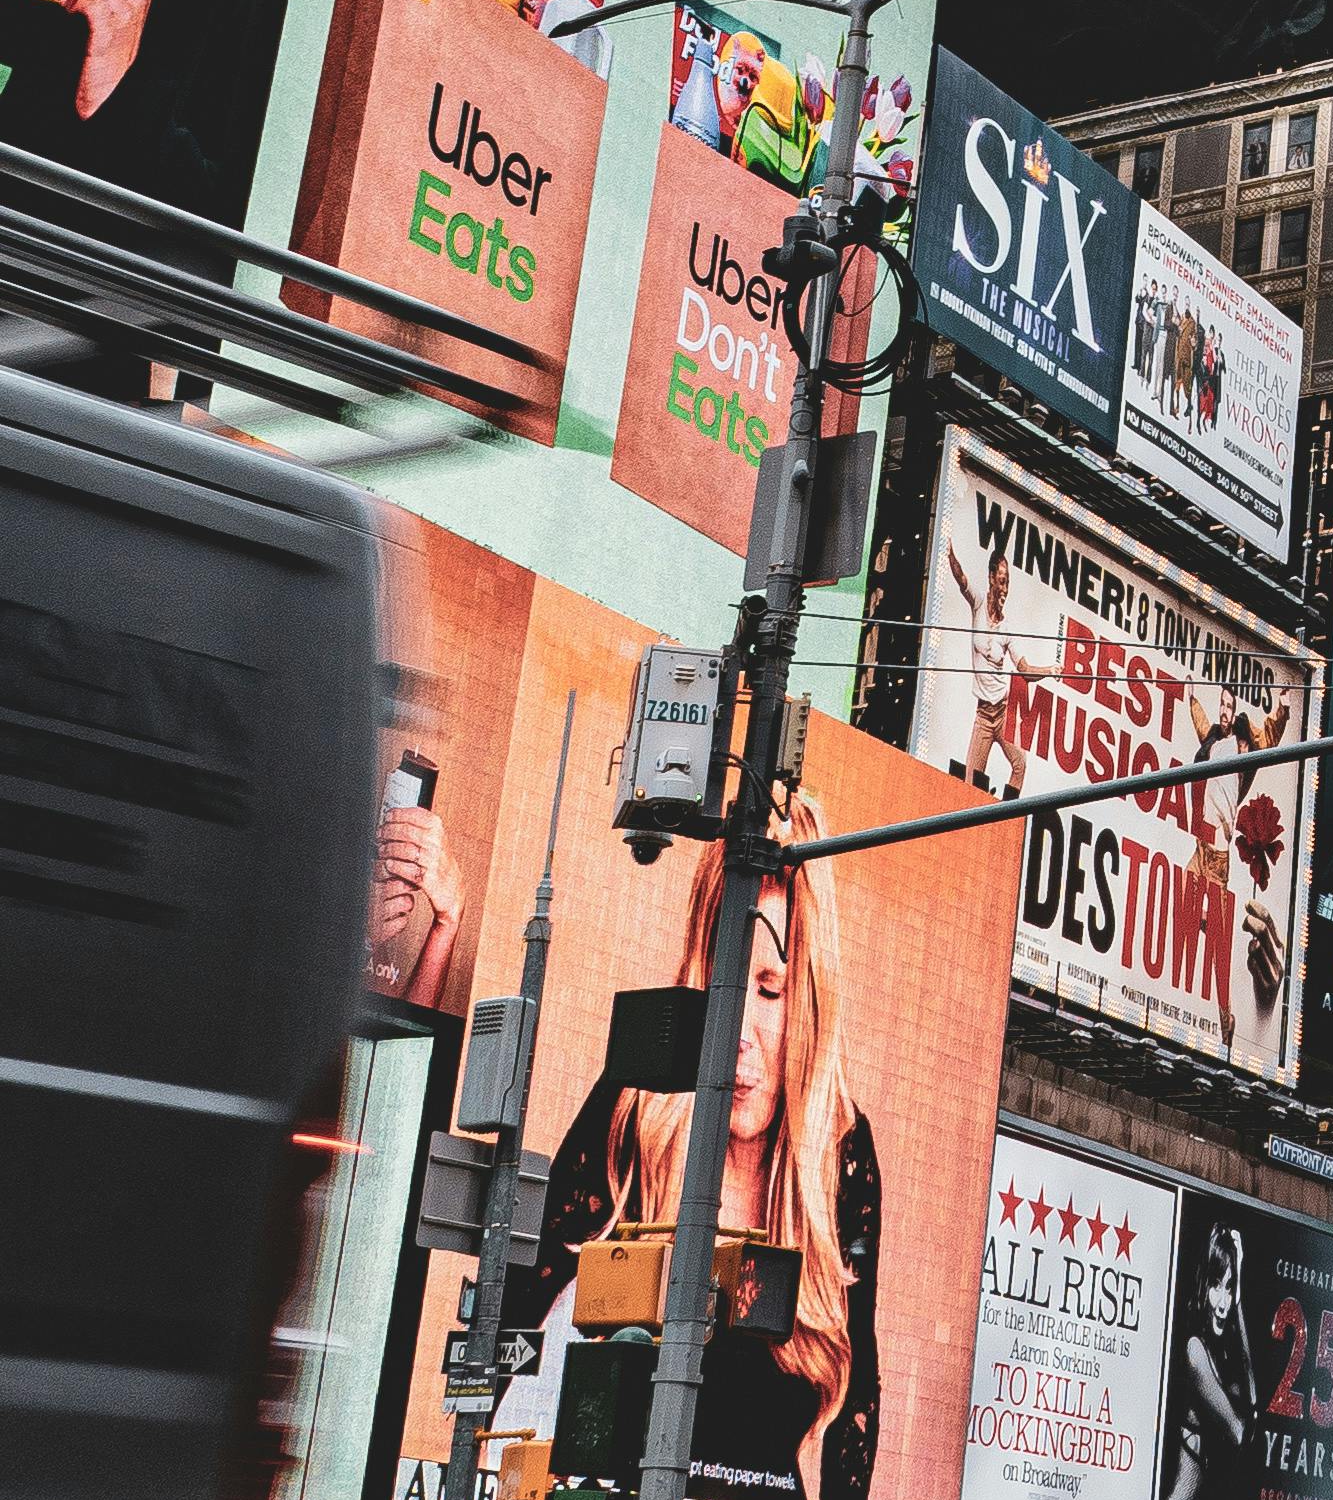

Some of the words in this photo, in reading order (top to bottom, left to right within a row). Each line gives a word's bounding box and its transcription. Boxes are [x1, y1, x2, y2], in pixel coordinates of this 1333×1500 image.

[427, 82, 555, 217] Uber
[407, 168, 539, 303] Eats
[689, 222, 786, 331] Uber
[952, 117, 1107, 353] SIX
[1148, 224, 1203, 276] BROADWAY'S
[1205, 269, 1245, 308] FUNNIEST
[1247, 303, 1274, 332] SMASH
[1277, 325, 1290, 344] HIT
[677, 286, 783, 403] Don't
[981, 278, 1006, 318] THE
[1013, 300, 1070, 363] MUSICAL
[1141, 239, 1160, 260] AND
[1163, 253, 1232, 318] INTERNATIONAL
[1235, 312, 1293, 365] PHENOMENON
[667, 353, 771, 469] Eats
[1228, 368, 1254, 400] THAT
[1255, 387, 1291, 434] GOES
[1235, 349, 1254, 377] THE
[1257, 360, 1288, 401] PLAY
[1141, 418, 1159, 439] NEW
[1160, 431, 1186, 458] WORLD
[1186, 451, 1213, 478] STAGES
[1254, 498, 1278, 523] STREET
[1225, 393, 1289, 471] WRONG
[976, 490, 1134, 634] WINNER!
[1137, 592, 1150, 642] 8
[1155, 601, 1202, 670] TONY
[1202, 632, 1275, 715] AWARDS
[646, 700, 707, 724] 726161
[1063, 616, 1185, 742] BEST
[1004, 674, 1217, 845] MUSICAL
[980, 1236, 1051, 1309] ALL
[1059, 1256, 1143, 1332] RISE
[982, 1299, 1001, 1325] for
[1004, 1306, 1025, 1332] the
[1028, 1312, 1091, 1348] MIRACLE
[1094, 1329, 1117, 1353] that
[1120, 1336, 1131, 1358] is
[1009, 1337, 1049, 1366] Aaron
[1053, 1346, 1100, 1378] Sorkin's
[1033, 1371, 1091, 1420] KILL
[1096, 1387, 1112, 1425] A
[704, 1464, 734, 1485] eating
[734, 1469, 763, 1489] paper
[765, 1470, 796, 1491] towels.
[1003, 1463, 1018, 1482] on
